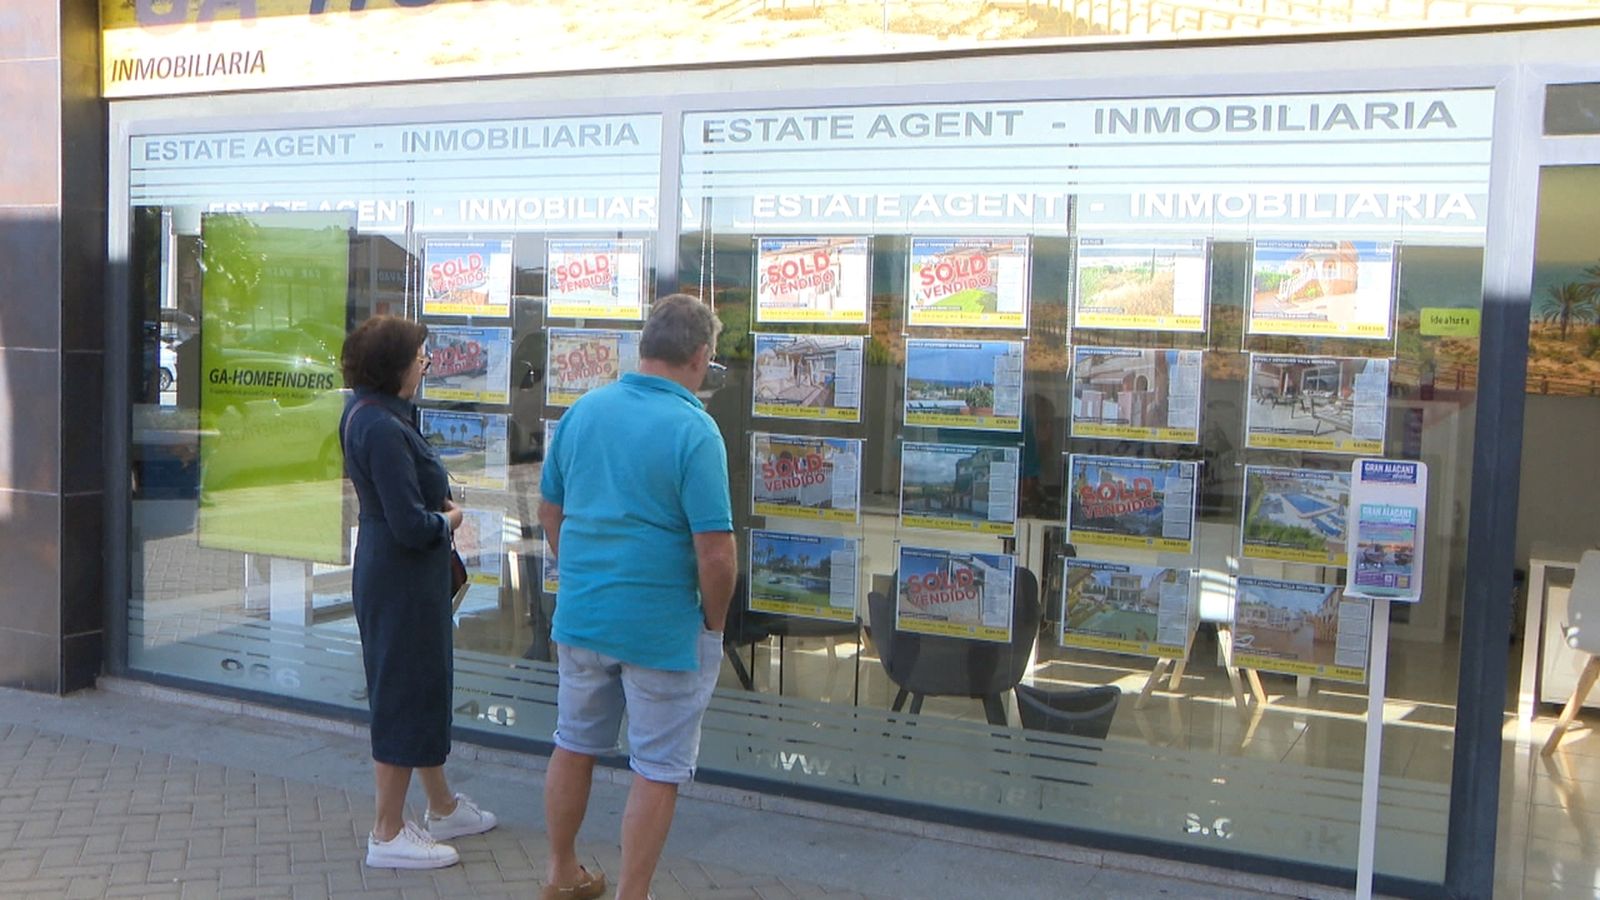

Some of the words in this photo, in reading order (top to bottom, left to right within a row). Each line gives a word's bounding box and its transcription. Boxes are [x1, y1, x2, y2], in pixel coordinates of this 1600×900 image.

[110, 49, 266, 82] INMOBILIARIA
[703, 114, 854, 144] ESTATE
[867, 110, 1024, 139] AGENT
[1094, 100, 1457, 135] INMOBILIARIA
[145, 138, 245, 161] ESTATE
[253, 133, 355, 158] AGENT
[402, 122, 639, 153] INMOBILIARIA
[753, 193, 897, 218] ESTATE
[912, 193, 1066, 218] AGENT
[1130, 192, 1477, 221] INMOBILIARIA
[431, 253, 483, 281] SOLD
[556, 254, 610, 283] SOLD
[767, 251, 830, 284] SOLD
[920, 254, 987, 287] SOLD
[770, 270, 833, 296] VENDIDO
[923, 273, 991, 300] VENDIDO
[556, 342, 610, 371] SOLD
[209, 368, 334, 390] GA-HOMEFINDERS
[558, 362, 613, 383] VENDIDO
[762, 453, 823, 479] SOLD
[1365, 463, 1384, 473] GRAN
[765, 473, 826, 493] VENDIDO
[1079, 477, 1154, 503] SOLD
[908, 568, 974, 593] SOLD
[911, 589, 977, 608] VENDIDO
